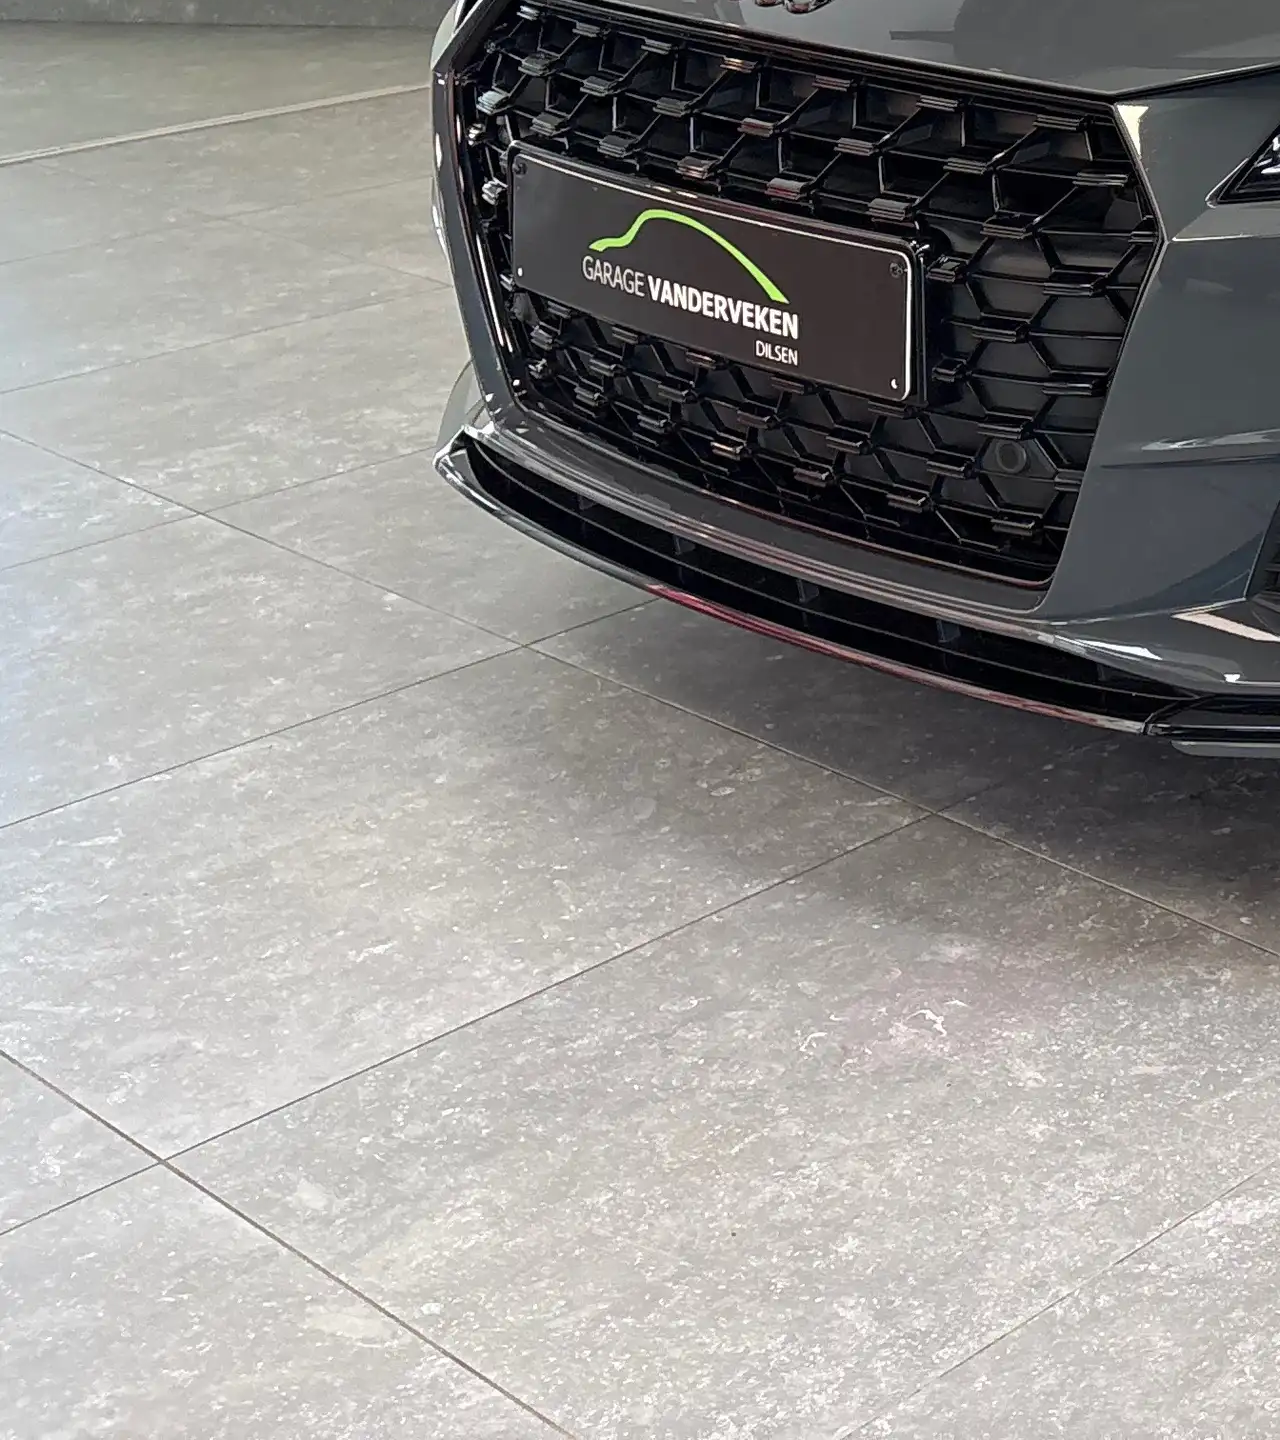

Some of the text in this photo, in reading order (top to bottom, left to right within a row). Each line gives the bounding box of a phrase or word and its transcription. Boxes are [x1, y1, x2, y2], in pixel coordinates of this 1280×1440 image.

[582, 255, 799, 340] GARAGE VANDERVEKEN
[755, 339, 799, 366] DILSEN
